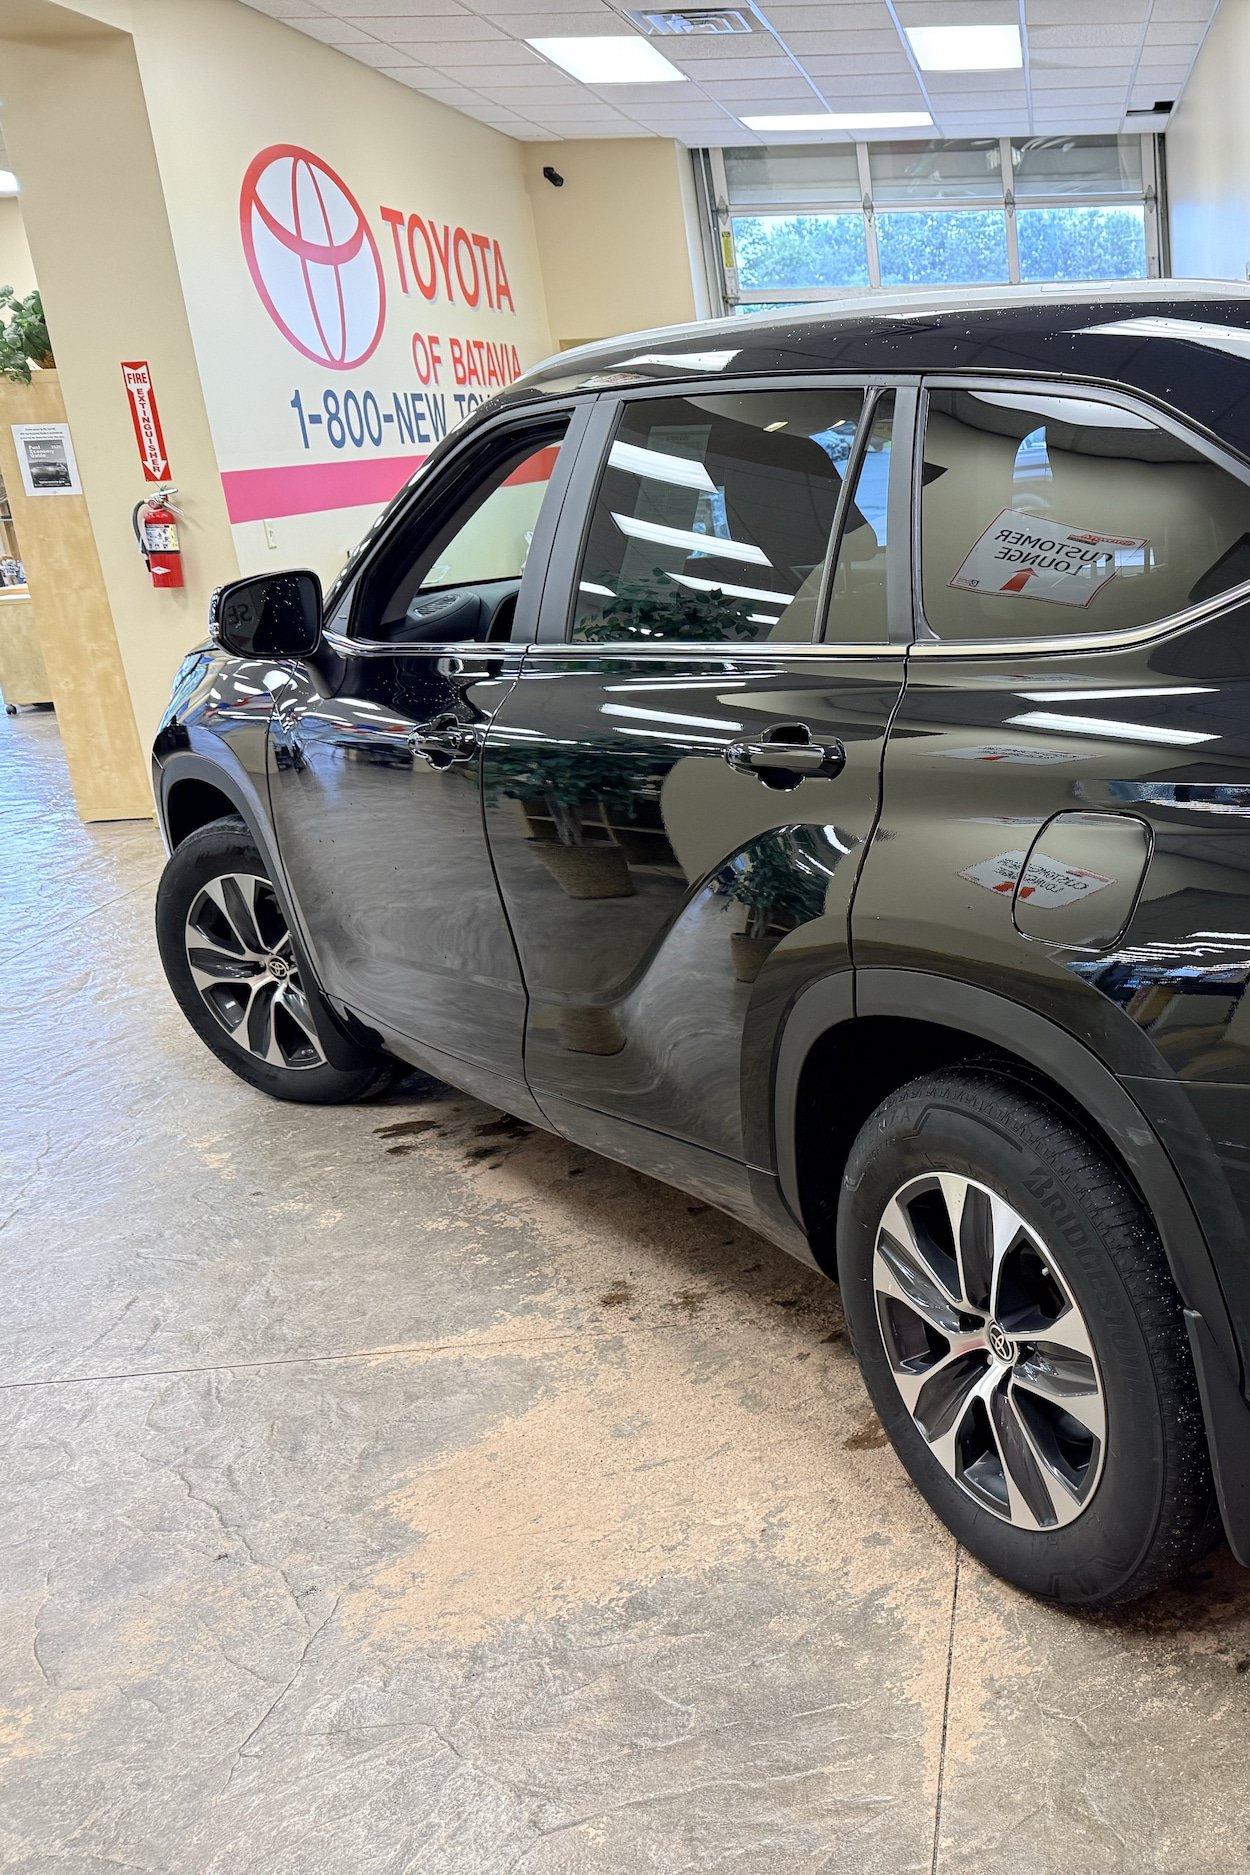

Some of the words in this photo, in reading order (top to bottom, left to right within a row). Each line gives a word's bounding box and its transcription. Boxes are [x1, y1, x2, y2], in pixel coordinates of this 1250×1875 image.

[380, 205, 515, 313] TOYOTA
[127, 373, 147, 384] FIRE
[412, 332, 442, 385] OF
[449, 337, 522, 387] BATAVIA
[136, 388, 160, 473] EXTINGUISHER
[290, 389, 447, 449] 1-800-NEW
